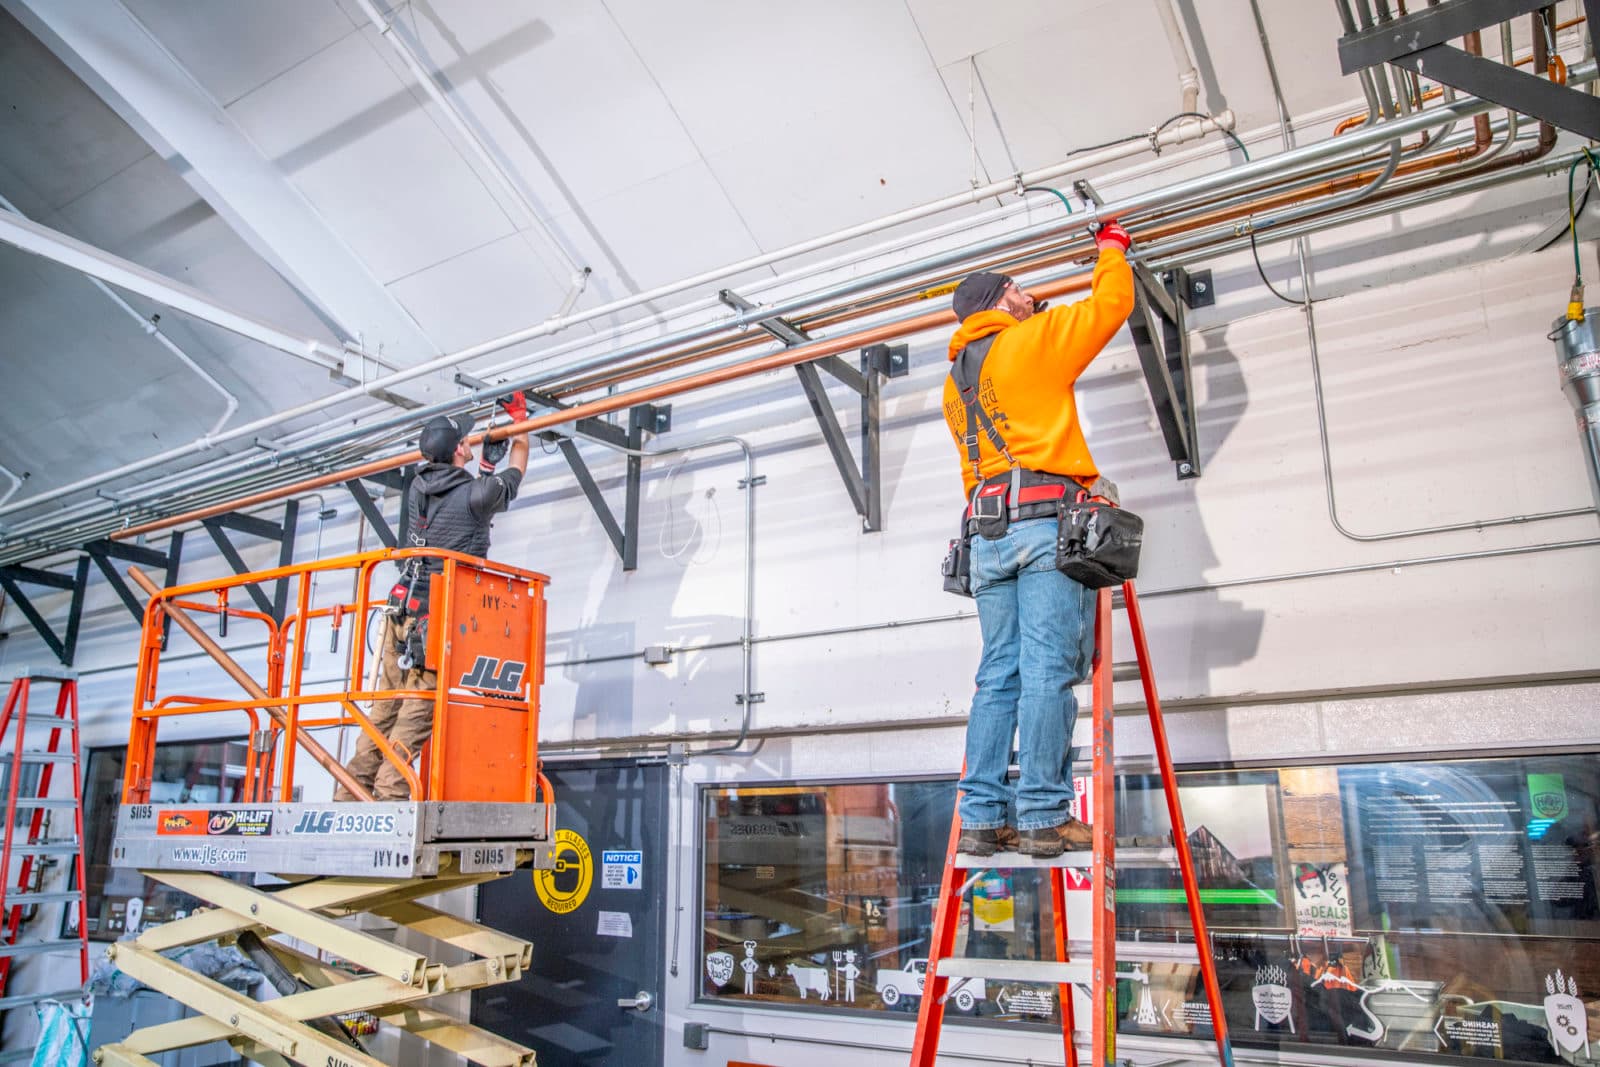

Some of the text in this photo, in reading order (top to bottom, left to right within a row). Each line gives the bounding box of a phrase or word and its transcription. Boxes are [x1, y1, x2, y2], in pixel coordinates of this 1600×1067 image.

[482, 593, 501, 611] IVY
[459, 655, 527, 693] JLG
[293, 811, 395, 833] JLG 1930ES
[172, 844, 248, 865] www.jlg.com
[606, 853, 640, 863] NOTICE
[546, 898, 578, 913] REQUIRED
[1311, 905, 1349, 921] DEALS
